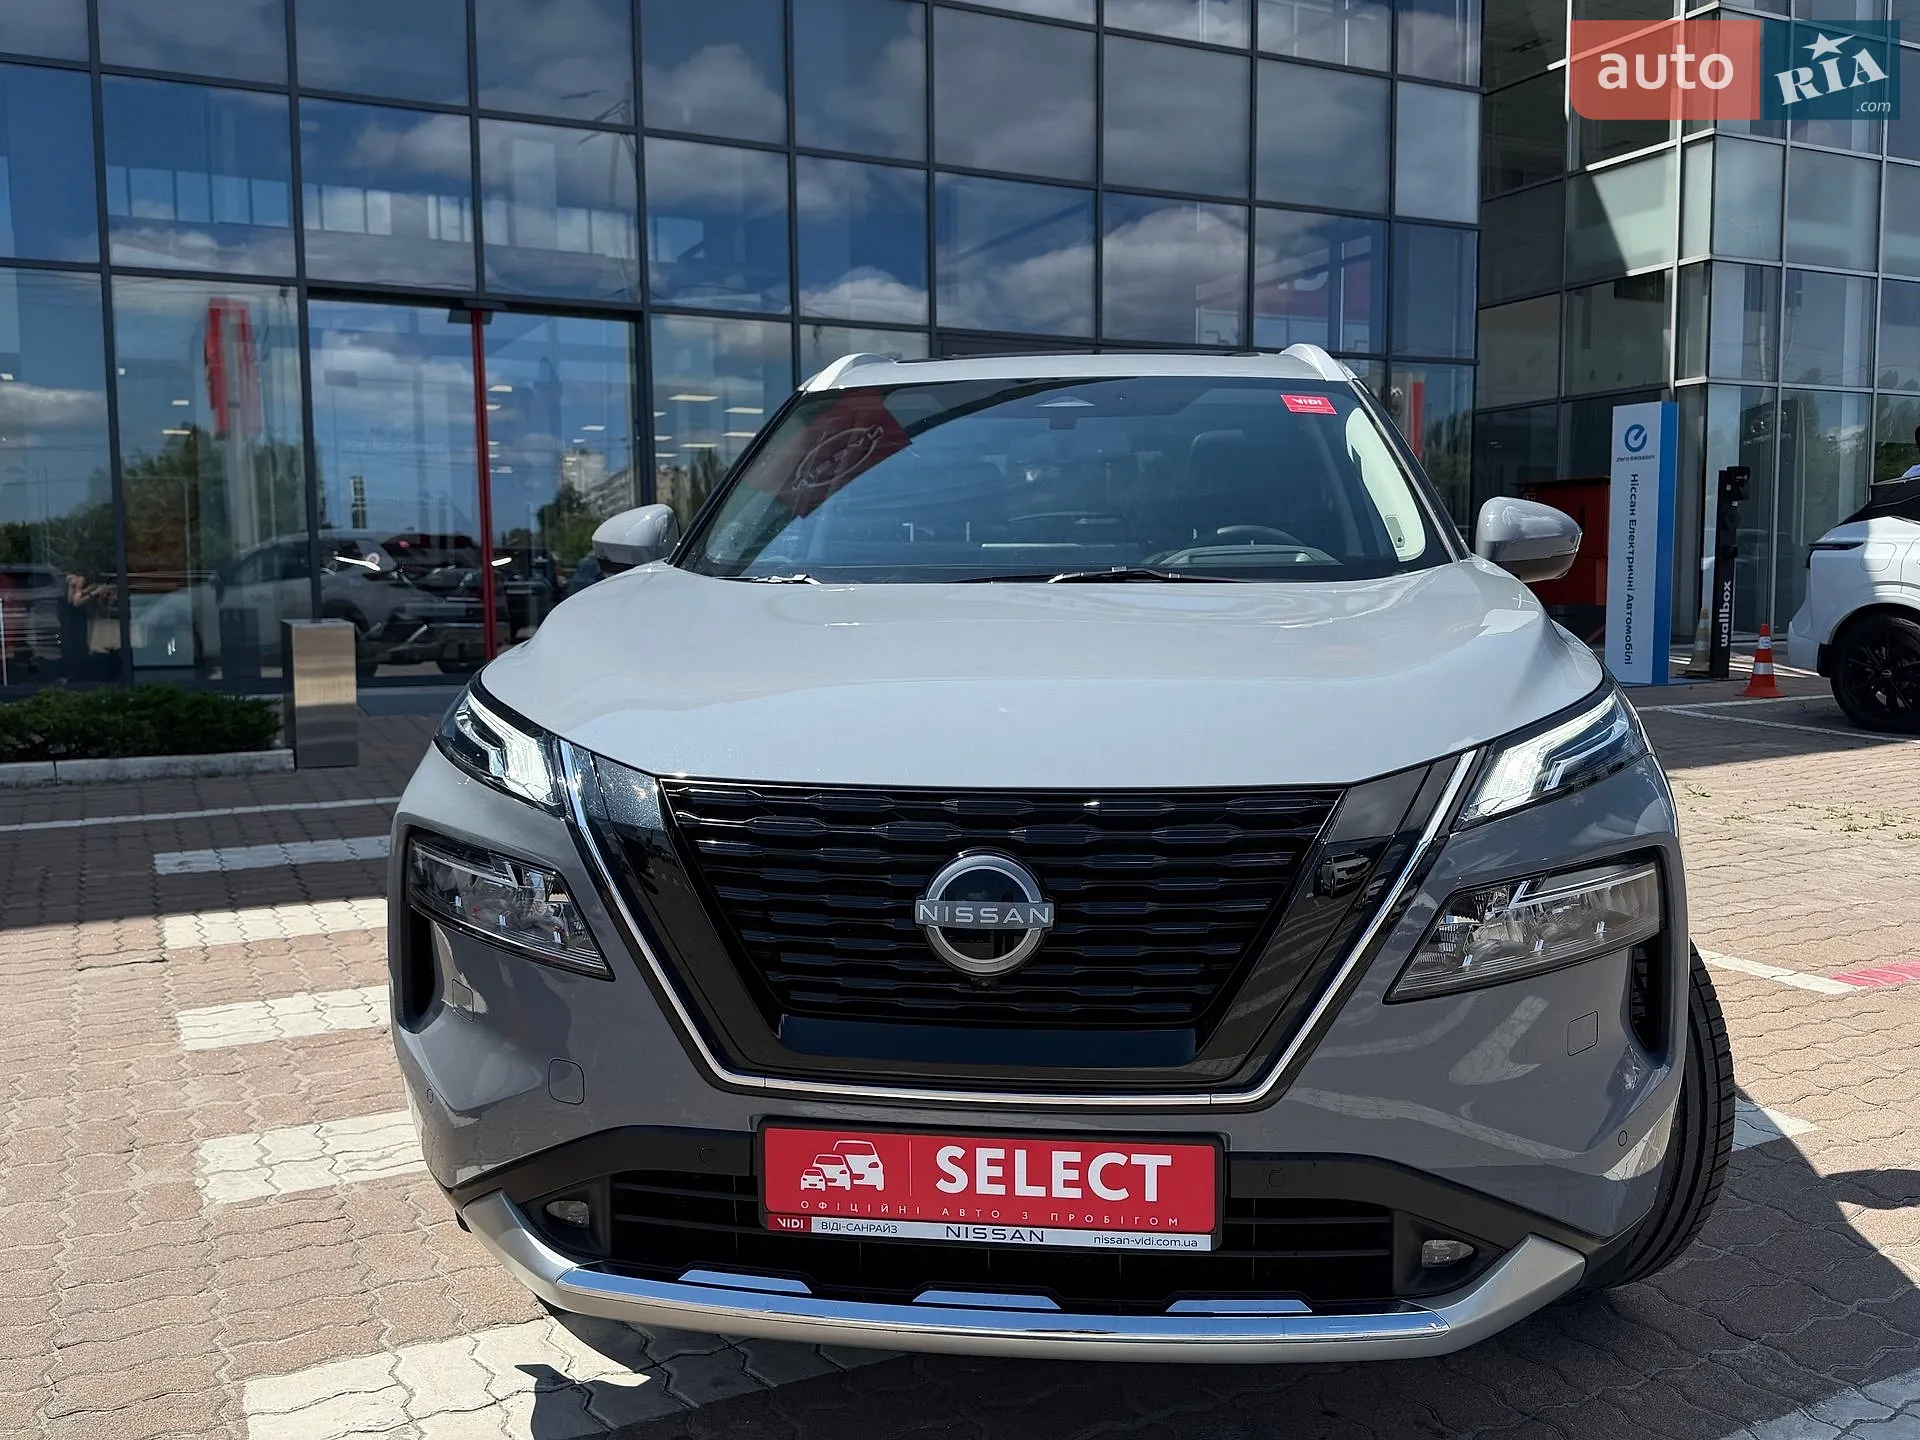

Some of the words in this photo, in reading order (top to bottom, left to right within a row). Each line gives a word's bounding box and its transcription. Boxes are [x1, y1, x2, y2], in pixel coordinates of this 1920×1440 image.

[1629, 473, 1640, 516] Ніссан
[1626, 519, 1637, 591] Електричні
[1718, 580, 1732, 648] wallbox
[1624, 593, 1635, 665] Автомобілі
[919, 904, 1049, 924] NISSAN
[935, 1145, 1172, 1202] SELECT
[776, 1217, 804, 1229] VIDI
[800, 1200, 921, 1216] ОФІЦІЙНІ
[941, 1207, 1001, 1220] АВТО
[1050, 1212, 1179, 1228] ПРОБІГОМ
[821, 1221, 898, 1234] ВІДІ-САНРАЙЗ
[945, 1225, 1045, 1243] NISSAN
[1093, 1234, 1198, 1248] nissan-vidi.com.ua
